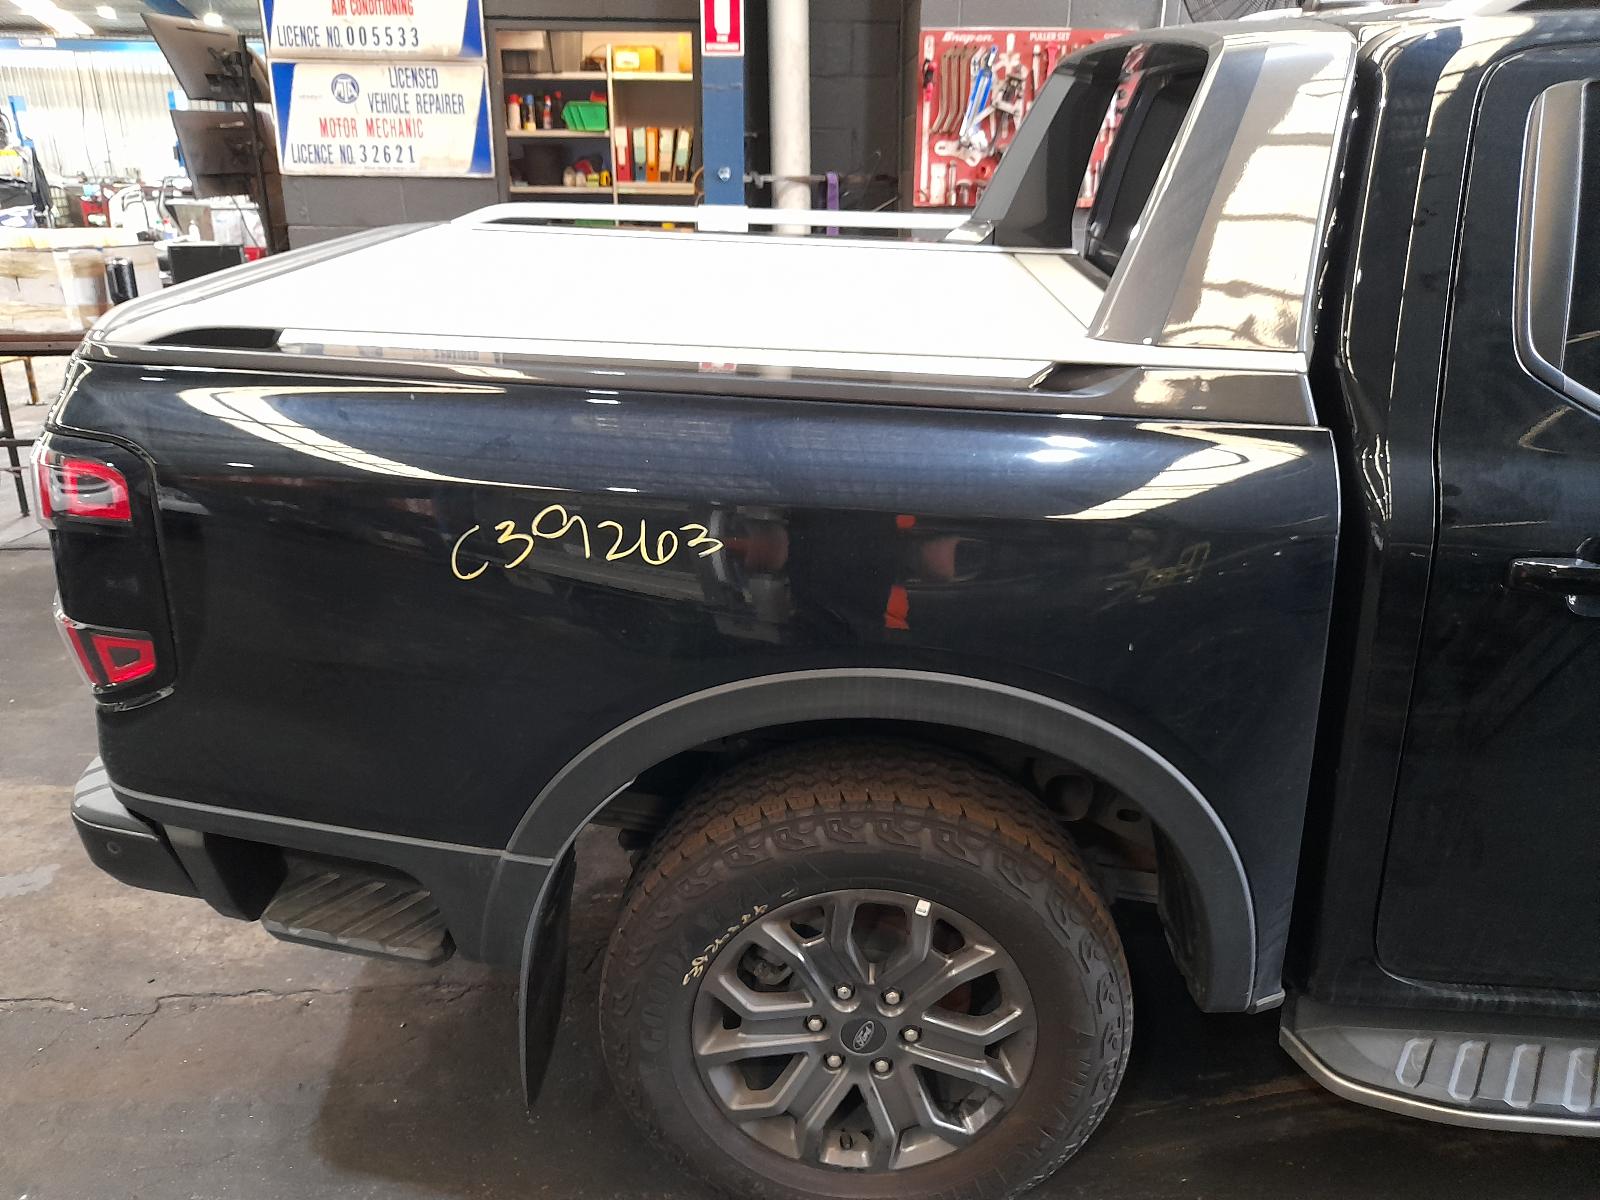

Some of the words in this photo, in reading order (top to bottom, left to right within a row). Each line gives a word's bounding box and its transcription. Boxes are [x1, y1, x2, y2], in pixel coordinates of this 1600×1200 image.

[332, 0, 347, 16] AIR
[351, 0, 414, 16] CONDITIONING
[277, 25, 321, 47] LICENCE
[346, 26, 419, 47] 005533
[388, 66, 439, 89] LICENSED
[368, 92, 411, 114] VEHICLE
[416, 93, 465, 115] REPAIRER
[319, 117, 358, 138] MOTOR
[366, 117, 424, 138] MECHANIC
[291, 143, 334, 164] LICENCE
[359, 144, 416, 164] 32621
